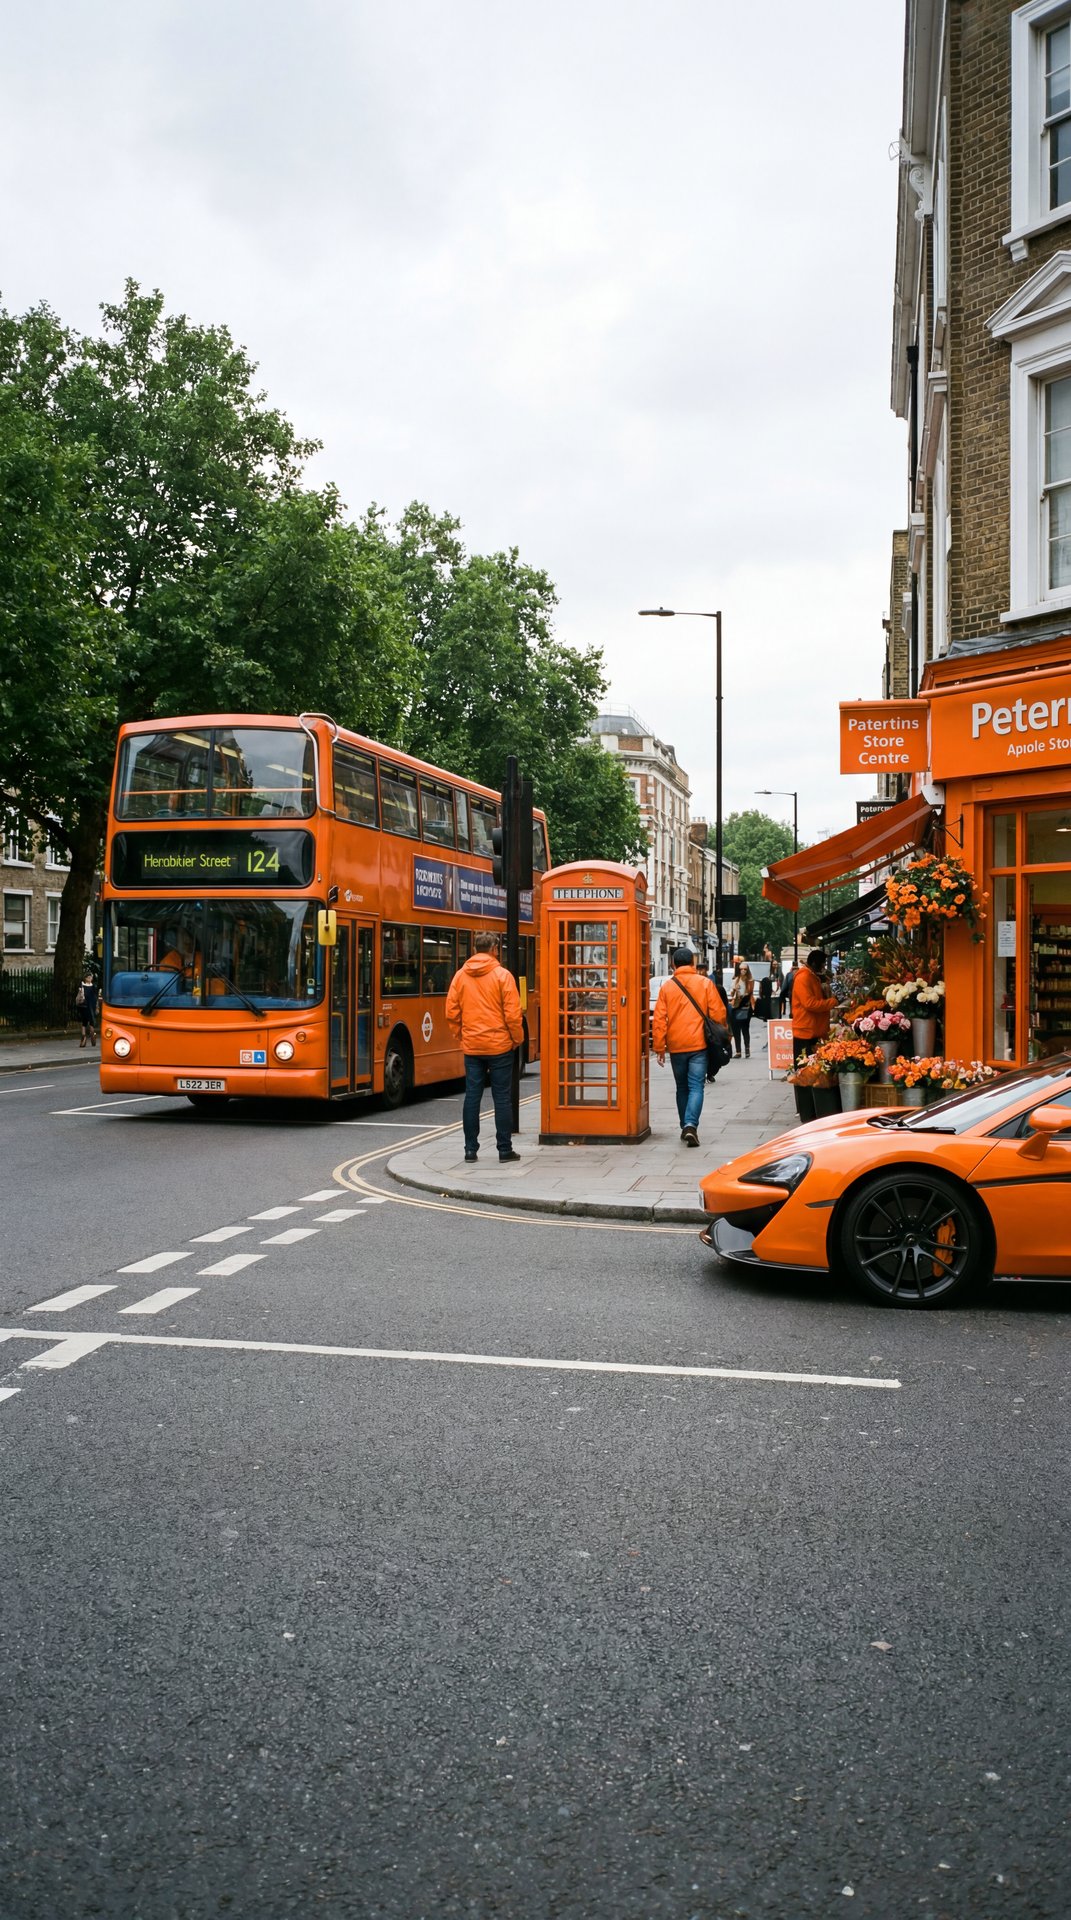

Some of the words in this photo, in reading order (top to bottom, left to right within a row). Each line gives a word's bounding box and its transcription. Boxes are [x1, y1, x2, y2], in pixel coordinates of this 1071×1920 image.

[848, 716, 919, 731] Patertins
[863, 735, 905, 748] Store
[1049, 737, 1071, 751] Sto
[858, 752, 910, 765] Centre
[199, 853, 232, 868] Street
[247, 850, 280, 873] 124
[556, 888, 622, 899] TELEPHONE
[205, 1081, 222, 1090] JER
